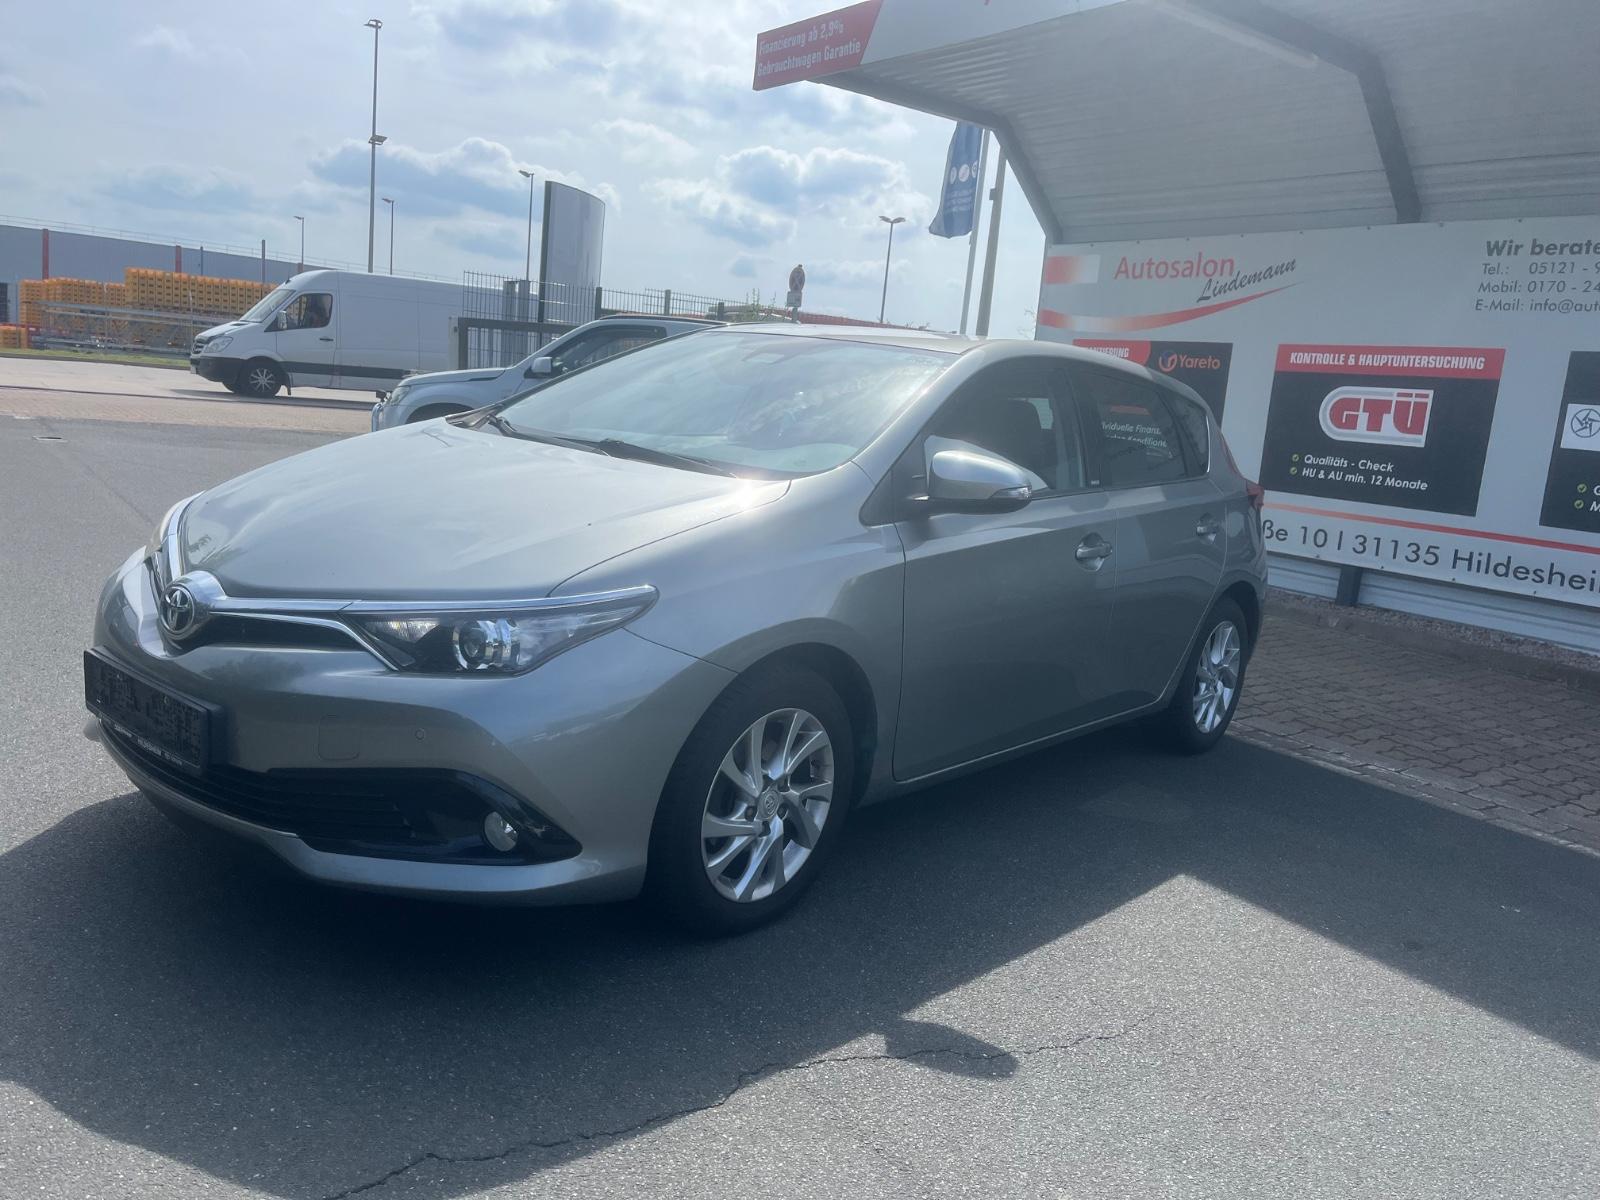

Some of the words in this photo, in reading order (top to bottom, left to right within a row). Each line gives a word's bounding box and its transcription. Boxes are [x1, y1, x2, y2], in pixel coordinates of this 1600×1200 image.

[808, 26, 818, 42] ab
[820, 19, 845, 41] 2,9%
[757, 51, 822, 77] Gebrauchtwagen
[824, 38, 861, 61] Garantie
[1486, 239, 1524, 257] Wir
[1114, 251, 1236, 280] Autosalon
[1482, 263, 1510, 275] Tel.:
[1529, 262, 1575, 275] 05121
[1196, 258, 1297, 303] Lindemann
[1478, 280, 1522, 293] Mobil:
[1527, 280, 1566, 293] 0170
[1475, 298, 1524, 311] E-Mail:
[1530, 298, 1600, 314] info@aut
[1179, 355, 1221, 369] Yareto
[1290, 352, 1346, 365] KONTROLLE
[1347, 354, 1356, 365] &
[1358, 354, 1486, 370] HAUPTUNTERSUCHUNG
[1328, 392, 1430, 436] GTÜ
[1304, 454, 1348, 467] Qualitäts
[1358, 459, 1395, 472] Check
[1302, 467, 1317, 478] HU
[1328, 471, 1343, 481] AU
[1345, 473, 1367, 484] min.
[1371, 475, 1382, 486] 12
[1384, 477, 1429, 490] Monate
[1300, 525, 1329, 548] 10
[1352, 534, 1440, 566] 31135
[1451, 548, 1600, 593] Hildeshei
